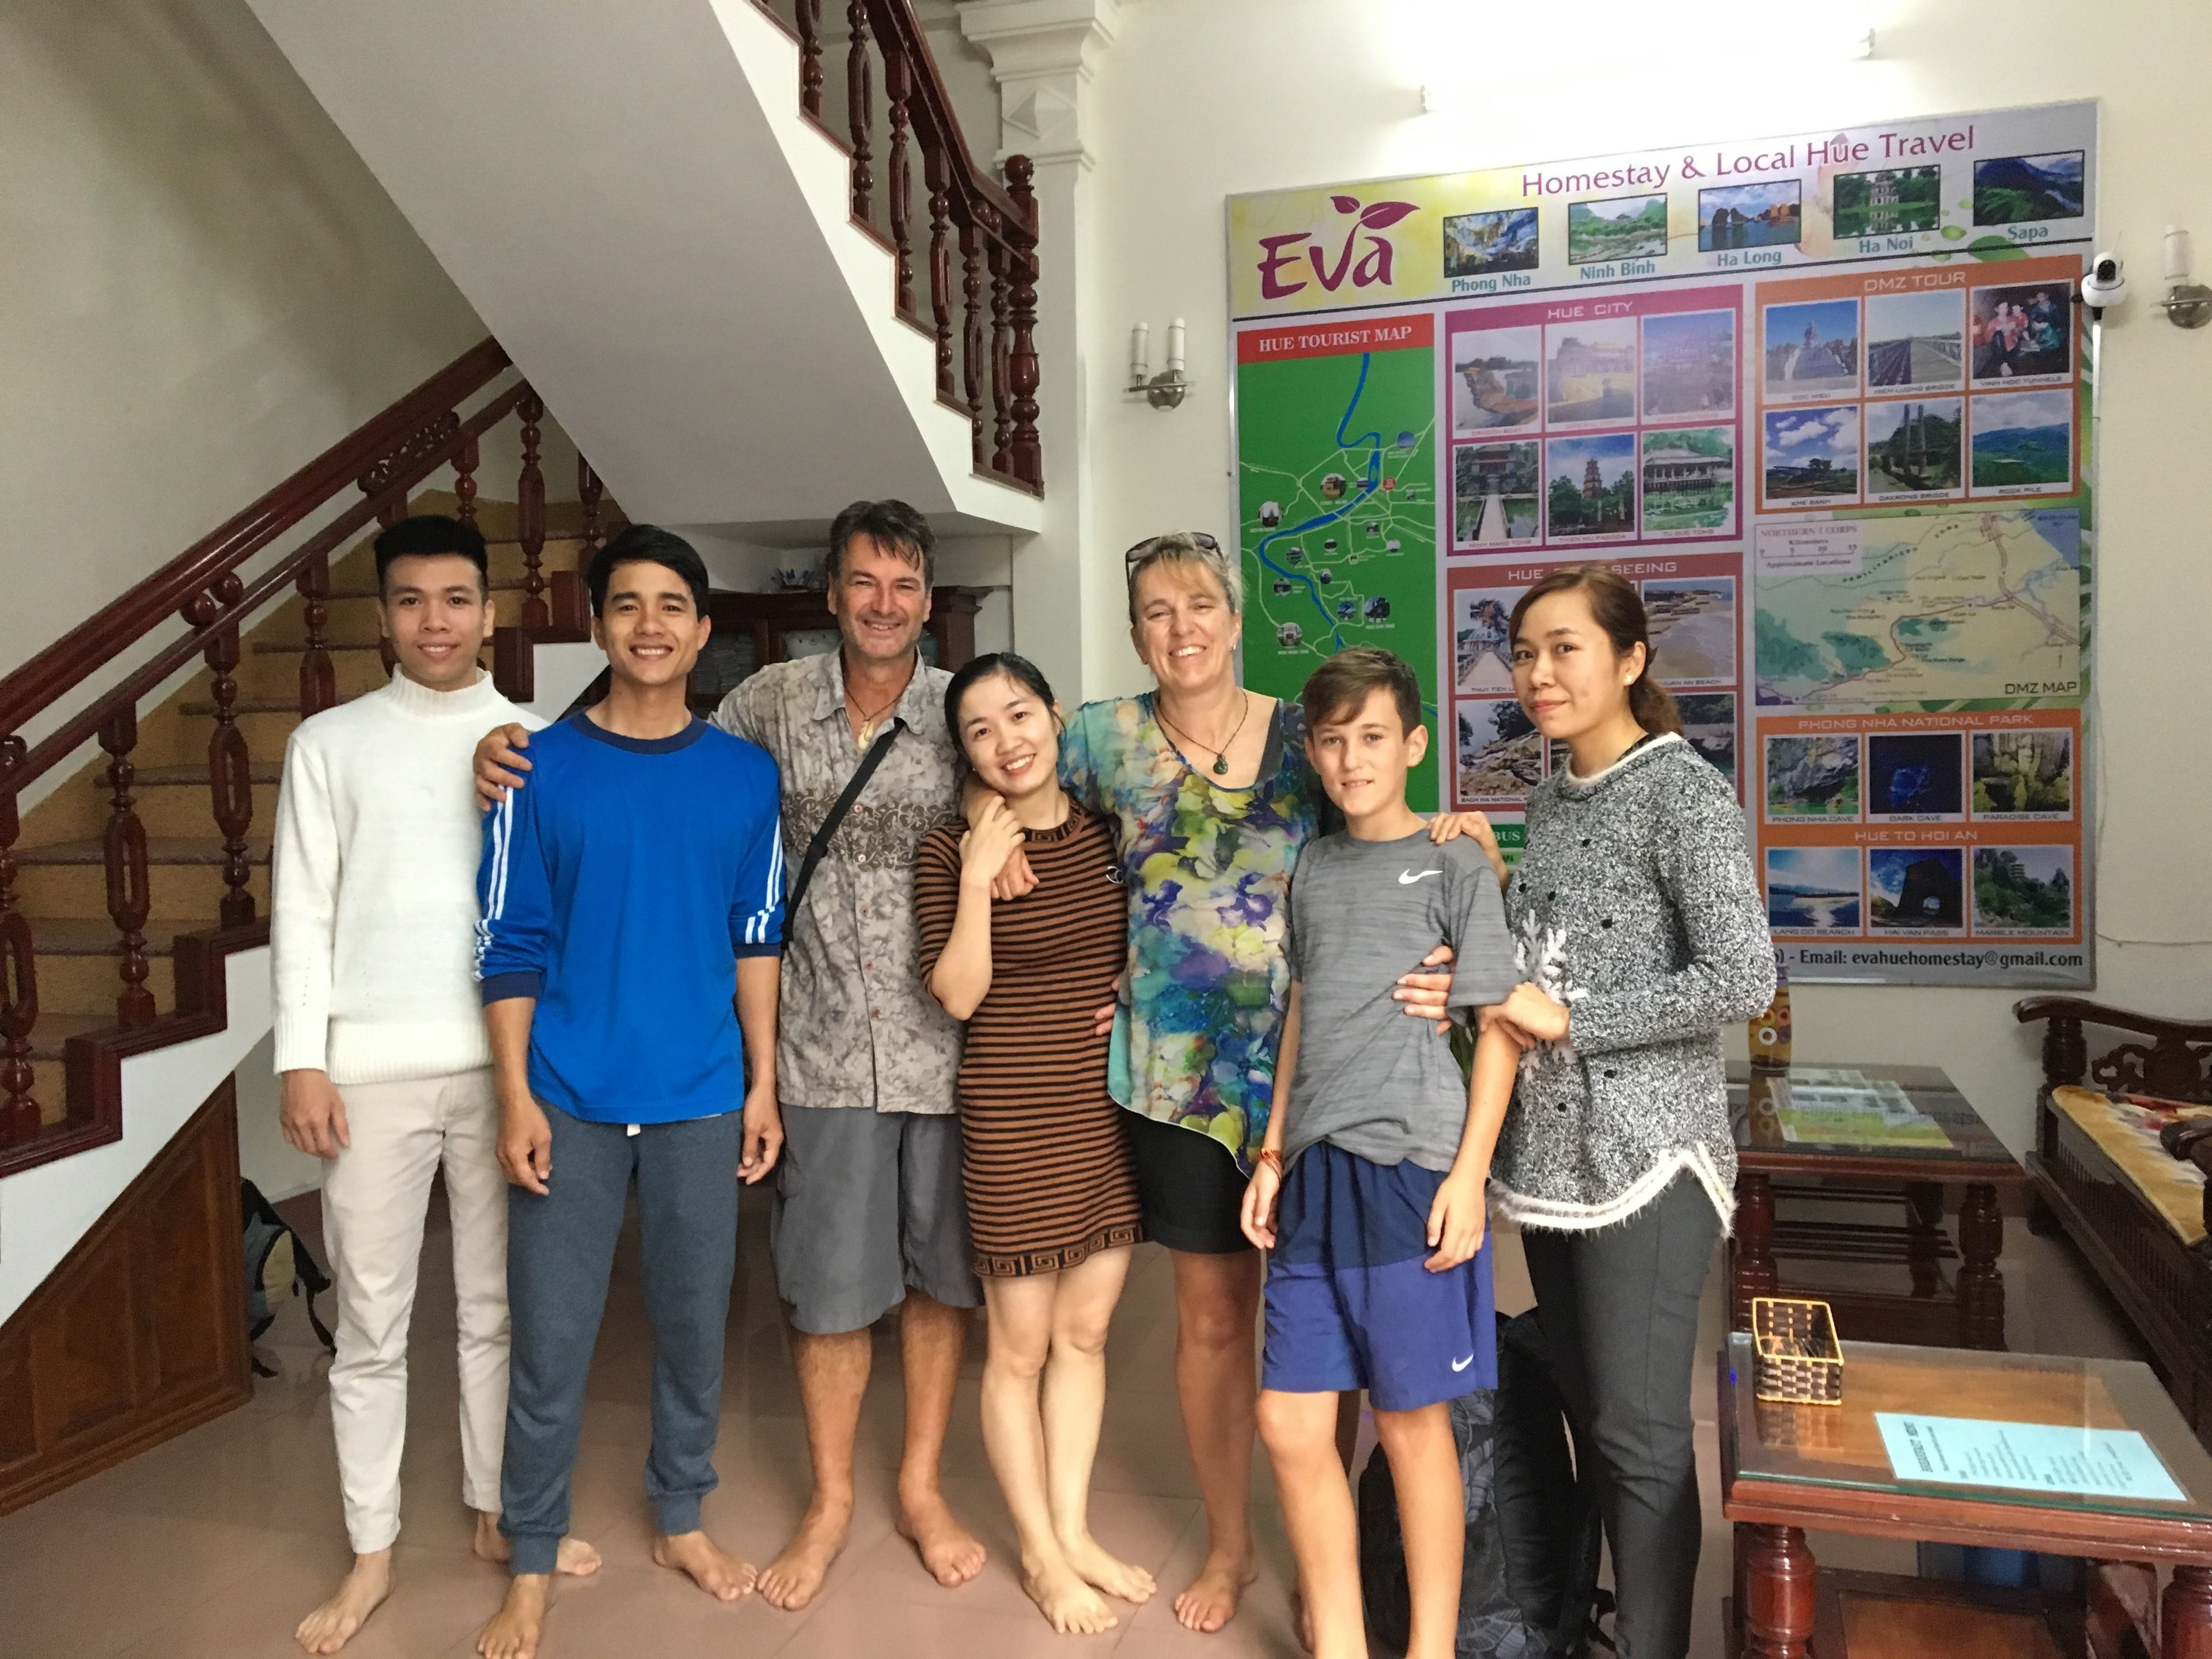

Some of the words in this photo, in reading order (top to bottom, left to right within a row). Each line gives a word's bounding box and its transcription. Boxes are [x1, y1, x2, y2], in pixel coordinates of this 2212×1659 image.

[1522, 165, 1671, 196] Homestay
[1681, 155, 1706, 180] &
[1717, 145, 1795, 177] Local
[1807, 138, 1869, 166] Hue
[1879, 126, 1975, 160] Travel
[2008, 224, 2048, 242] Sapa
[1859, 239, 1881, 253] Ha
[1884, 235, 1914, 251] Noi
[1717, 253, 1740, 267] Ha
[1744, 250, 1782, 266] Long
[1580, 264, 1615, 280] Ninh
[1864, 276, 1907, 291] DMZ
[1911, 271, 1967, 289] TOUR
[1452, 278, 1497, 293] Phong
[1502, 274, 1531, 288] Nha
[1548, 306, 1584, 319] HUE
[1595, 301, 1633, 316] CITY
[1259, 337, 1294, 353] HUE
[1298, 330, 1371, 349] TOURIST
[1374, 326, 1412, 342] MAP
[1508, 569, 1544, 581] HUE
[1612, 562, 1677, 575] SEEING
[2005, 683, 2041, 694] DMZ
[2043, 681, 2077, 692] MAP
[1798, 719, 1858, 730] PHONG
[1862, 718, 1898, 728] NHA
[1902, 716, 1984, 728] NATIONAL
[1990, 714, 2035, 725] PARK
[1855, 831, 1889, 841] HUE
[1894, 831, 1915, 841] TO
[1921, 831, 1950, 841] HOI
[1954, 830, 1978, 840] AN
[1801, 949, 1847, 964] Email:
[1852, 950, 2082, 969] evahuehomestay@gmail.com
